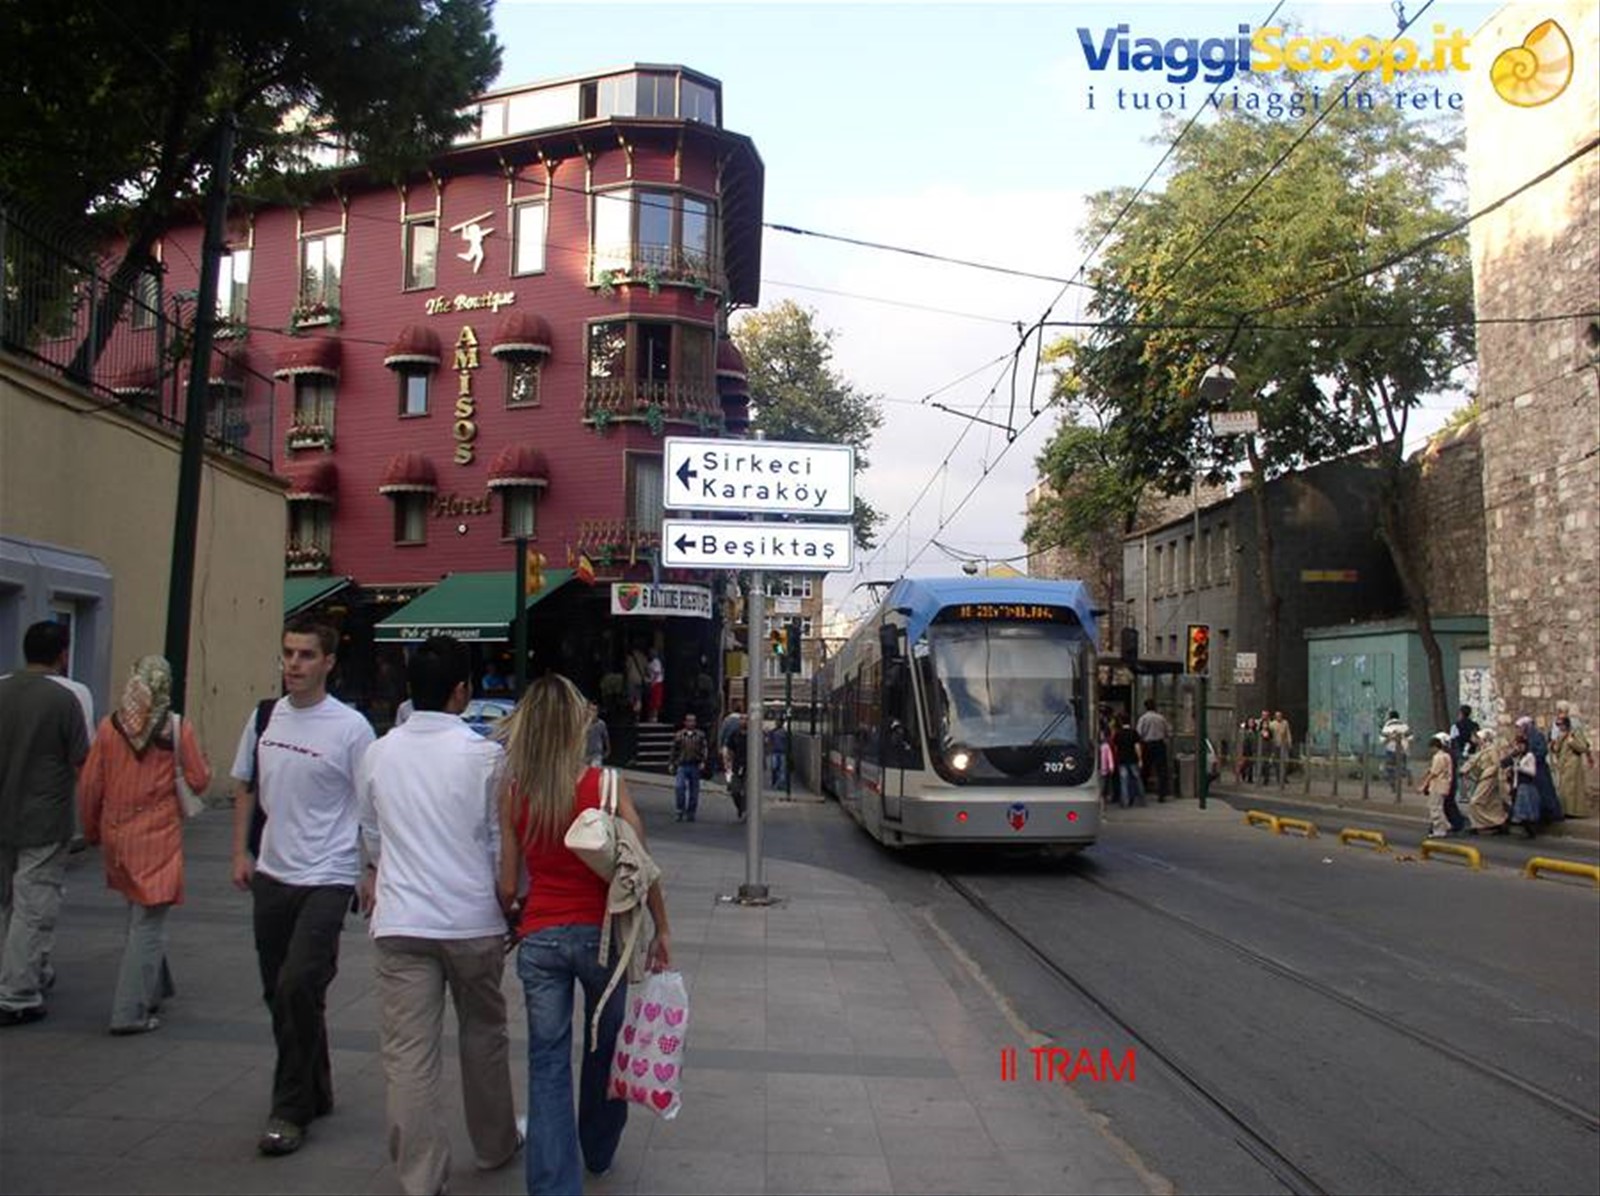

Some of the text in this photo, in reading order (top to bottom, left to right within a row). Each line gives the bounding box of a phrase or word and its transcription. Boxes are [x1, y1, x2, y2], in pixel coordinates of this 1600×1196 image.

[425, 296, 452, 315] The
[703, 451, 812, 475] Sirkeci
[702, 479, 828, 507] Karaköy
[701, 535, 836, 559] Beşiktaş
[1044, 762, 1064, 772] 707
